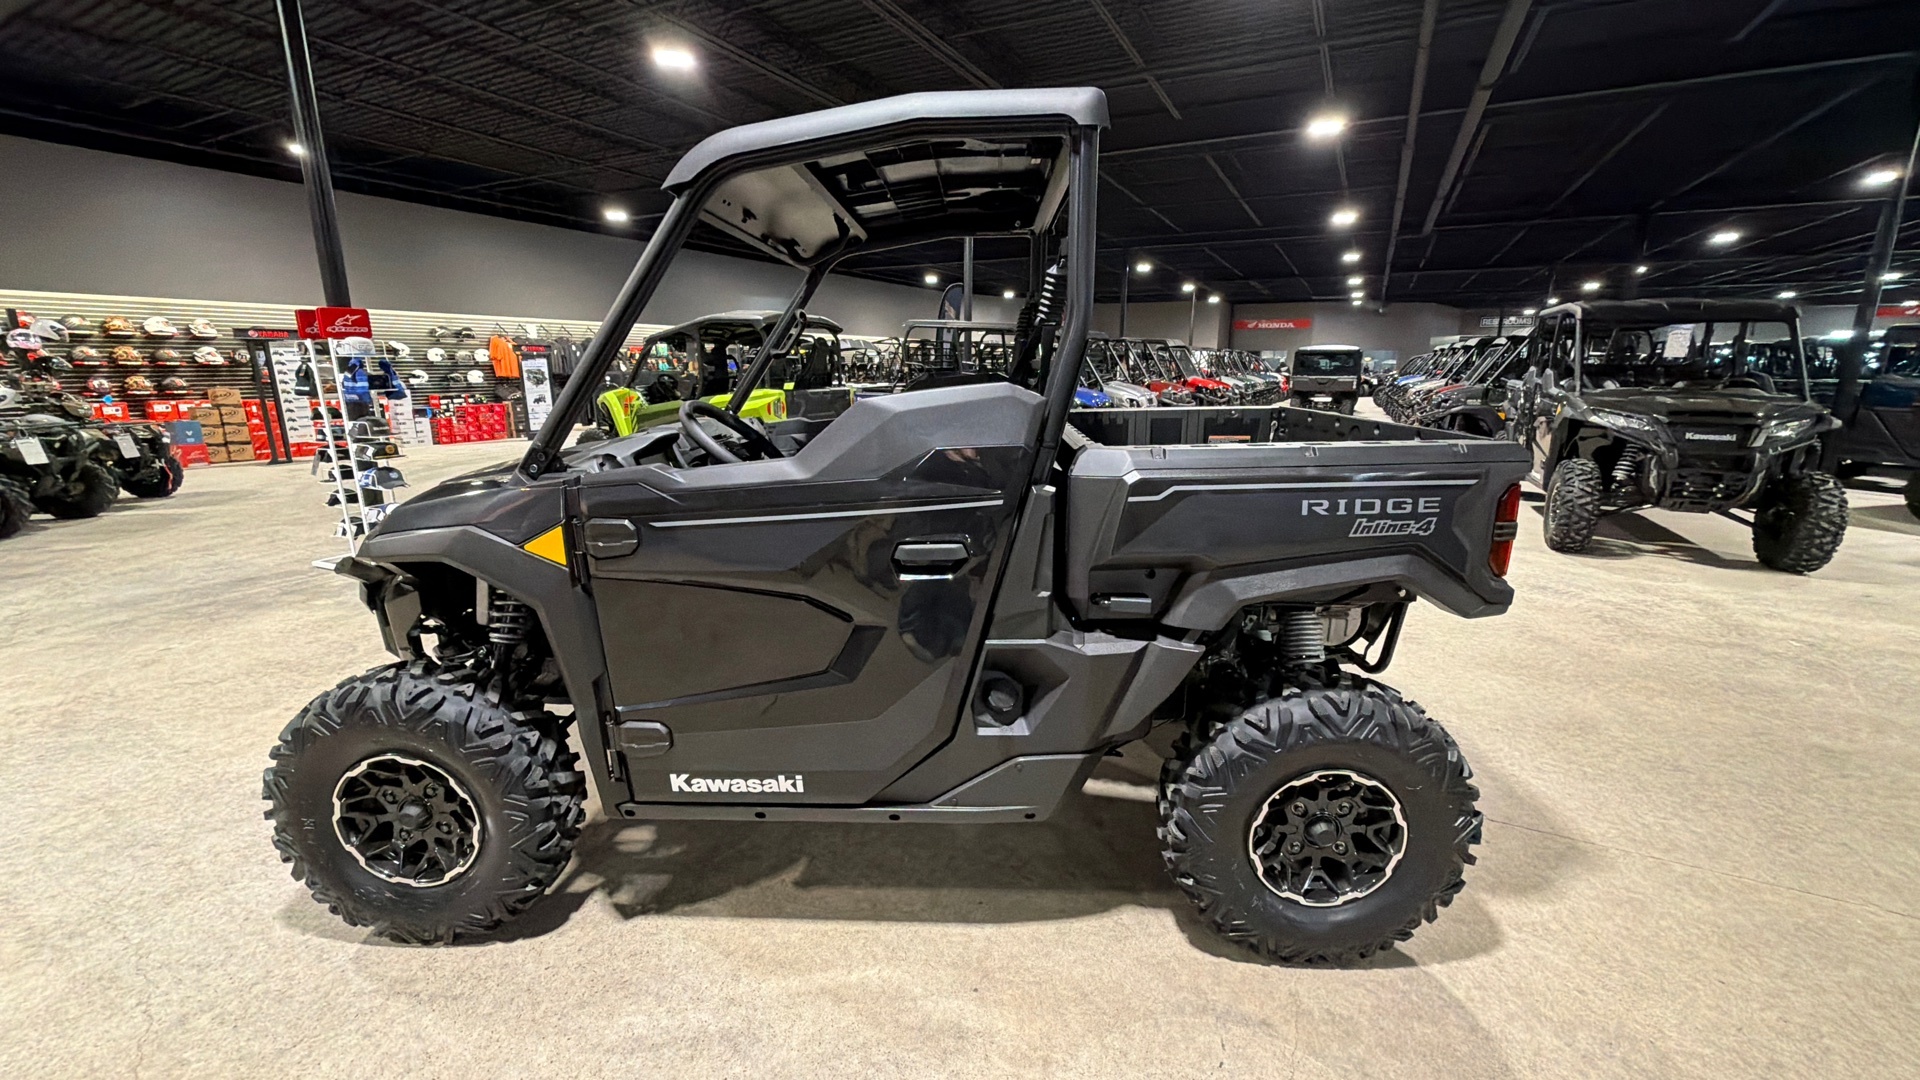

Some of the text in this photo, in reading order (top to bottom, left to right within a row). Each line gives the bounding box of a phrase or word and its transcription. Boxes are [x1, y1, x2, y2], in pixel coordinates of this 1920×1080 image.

[1685, 432, 1737, 441] Kawasaki
[1301, 497, 1442, 516] RIDGE
[1348, 517, 1438, 538] Inline-4
[669, 773, 805, 793] Kawasaki
